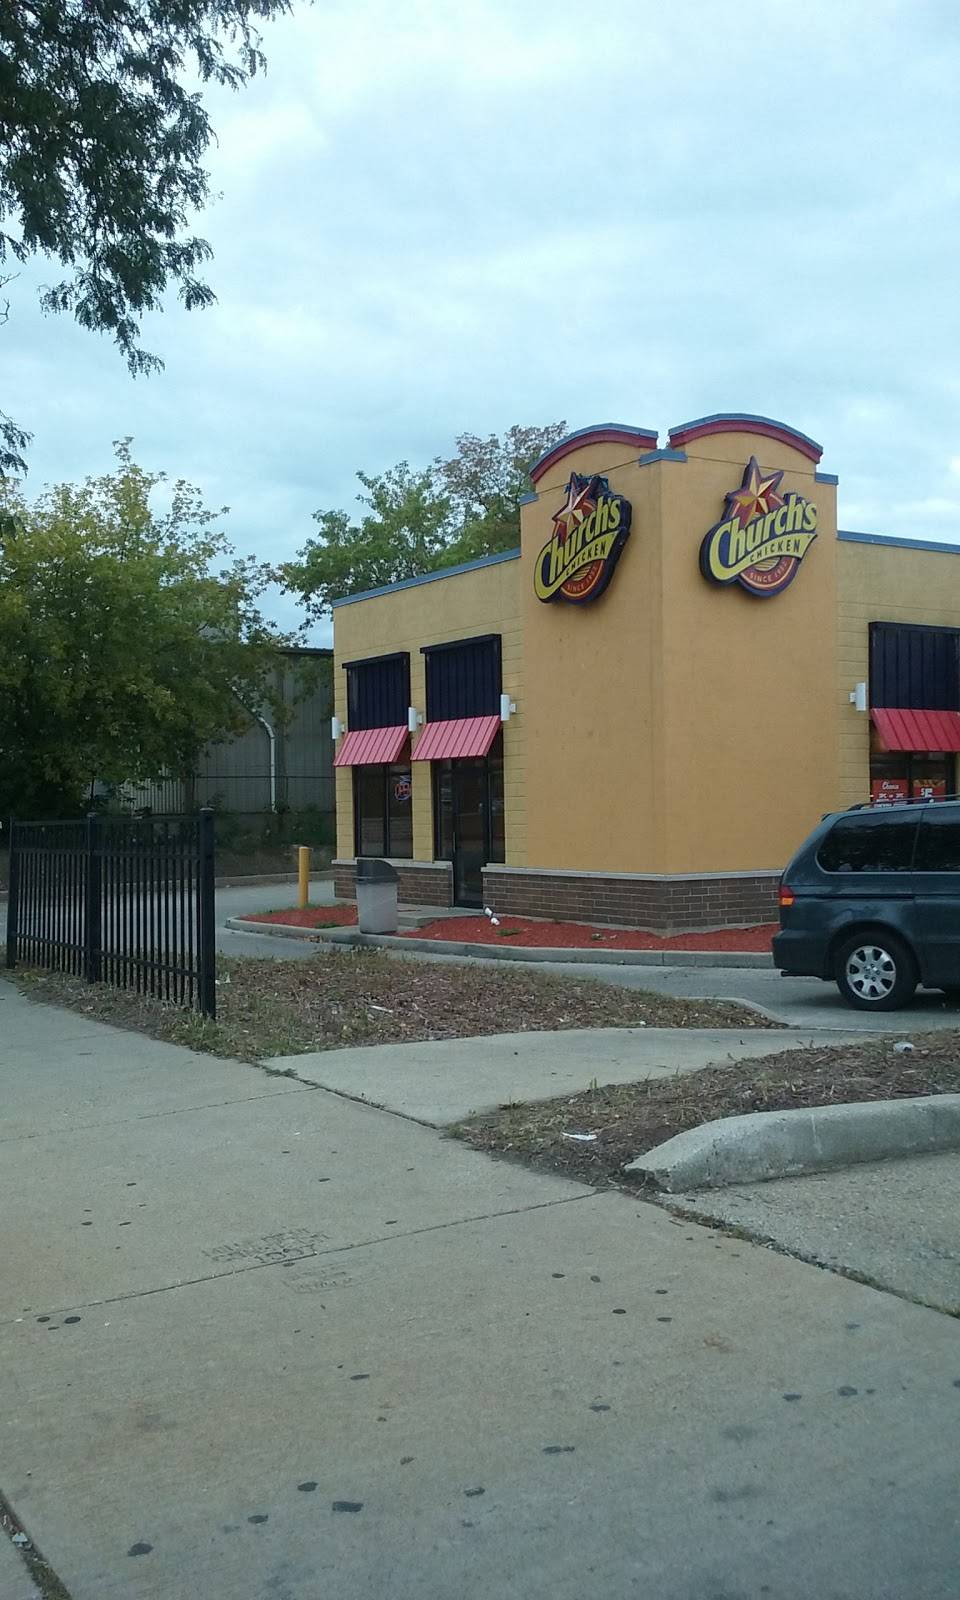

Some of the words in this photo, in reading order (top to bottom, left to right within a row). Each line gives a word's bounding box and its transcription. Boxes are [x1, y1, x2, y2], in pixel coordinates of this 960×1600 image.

[534, 496, 620, 600] Church's
[709, 494, 817, 581] Church's
[749, 539, 801, 563] CHICKEN
[565, 541, 607, 576] CHICKEN
[749, 571, 773, 583] SINCE
